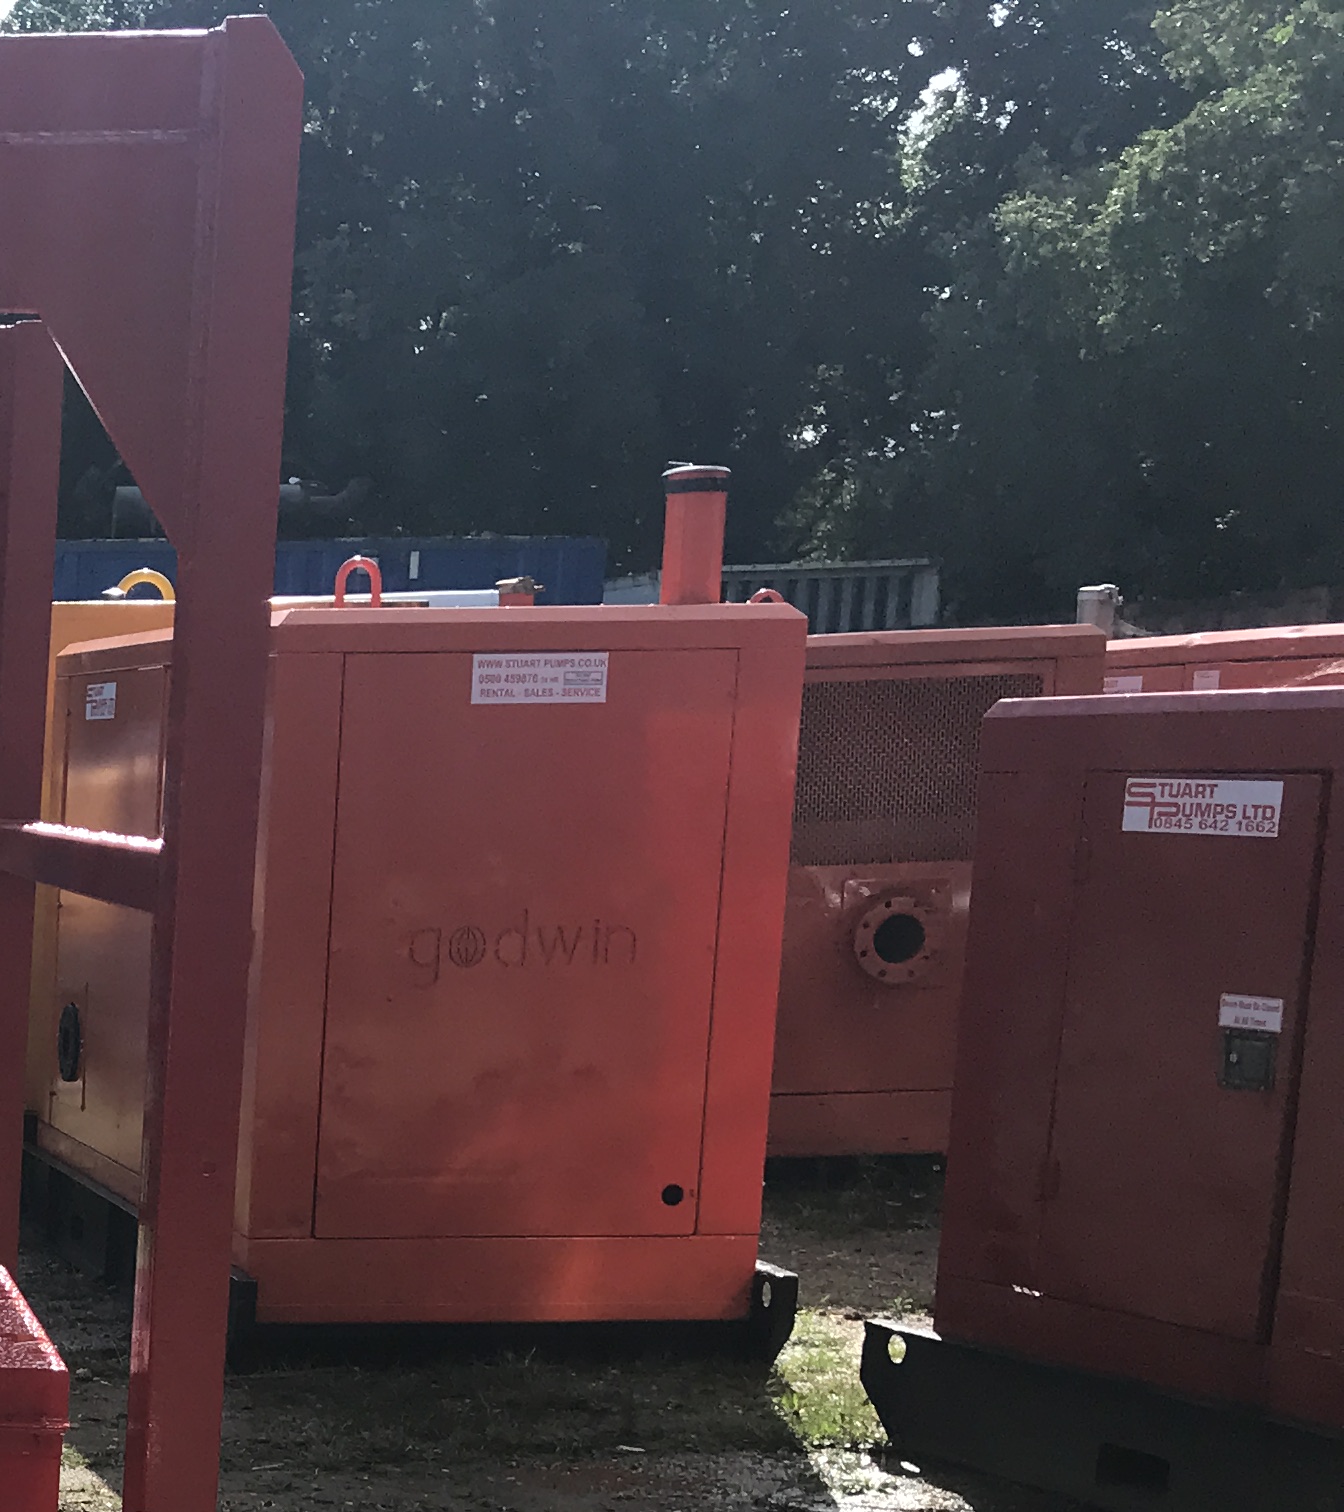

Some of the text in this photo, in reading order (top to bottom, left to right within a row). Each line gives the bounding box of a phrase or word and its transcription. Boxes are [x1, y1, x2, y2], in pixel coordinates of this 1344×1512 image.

[480, 688, 515, 698] RENTAL
[524, 688, 553, 698] SALES
[561, 687, 601, 697] SERVICE
[1126, 782, 1218, 801] STUART
[1125, 802, 1276, 821] PUMPS LTD
[1154, 817, 1276, 833] 0845 642 1662
[409, 908, 636, 989] godwin
